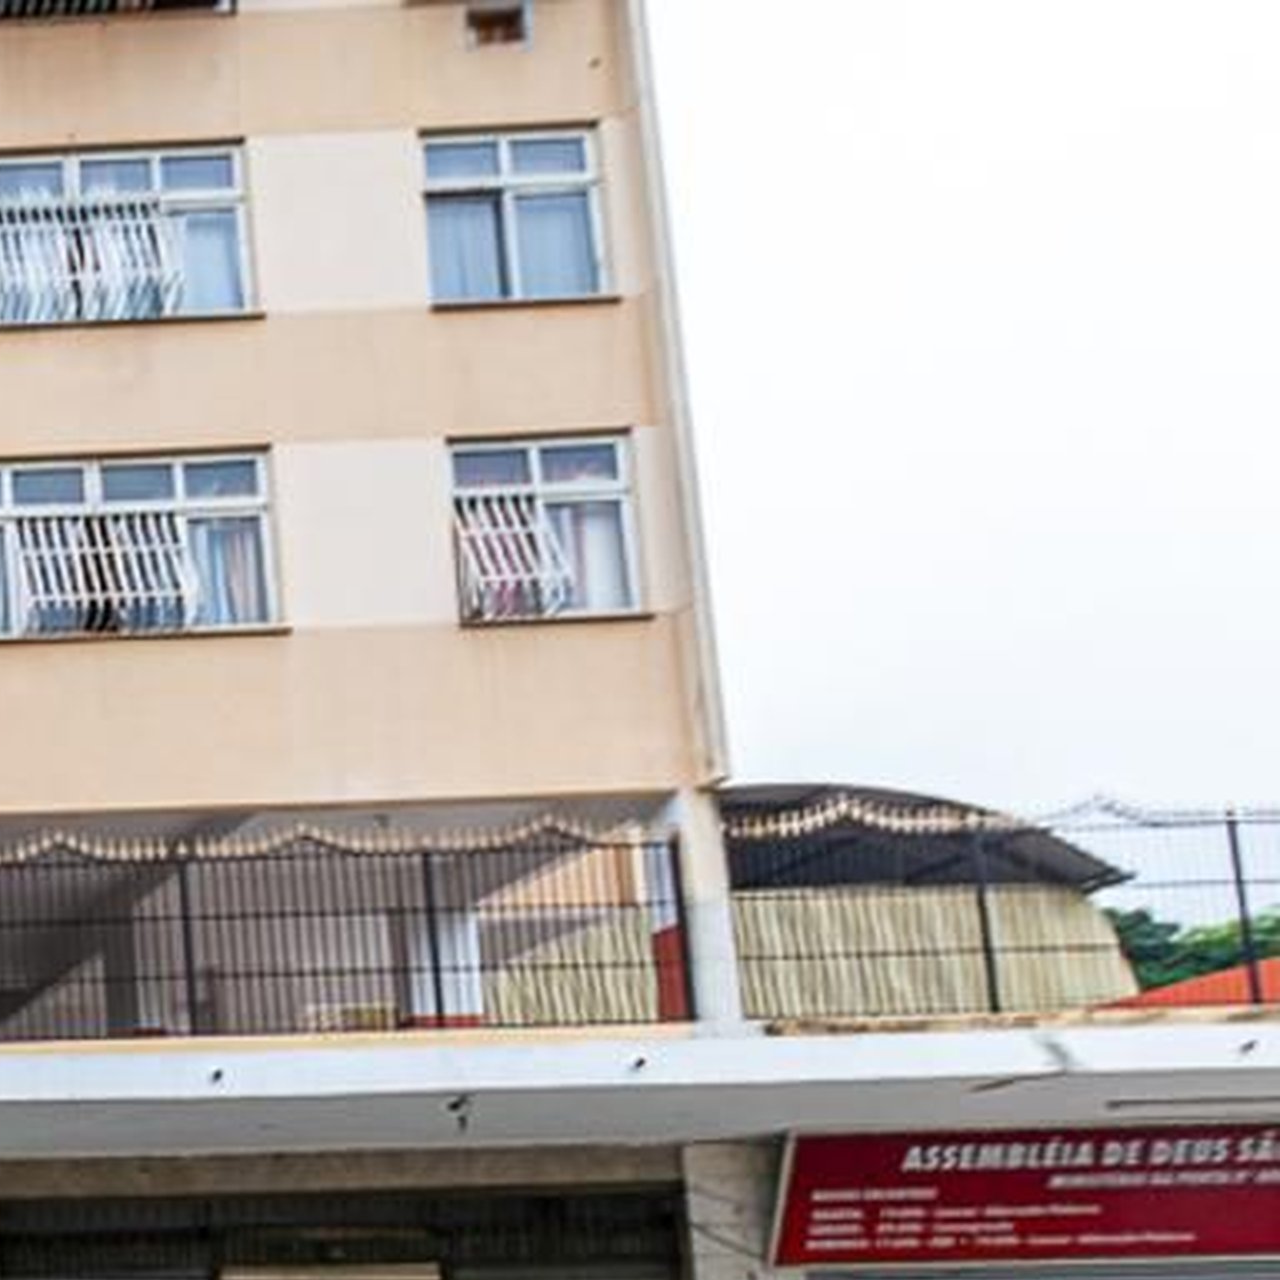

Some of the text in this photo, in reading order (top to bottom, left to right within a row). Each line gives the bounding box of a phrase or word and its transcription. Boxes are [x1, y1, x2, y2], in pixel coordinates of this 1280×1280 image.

[901, 1136, 1094, 1172] ASSEMBLÉIA
[1101, 1140, 1144, 1166] DE
[1148, 1138, 1231, 1165] DEUS
